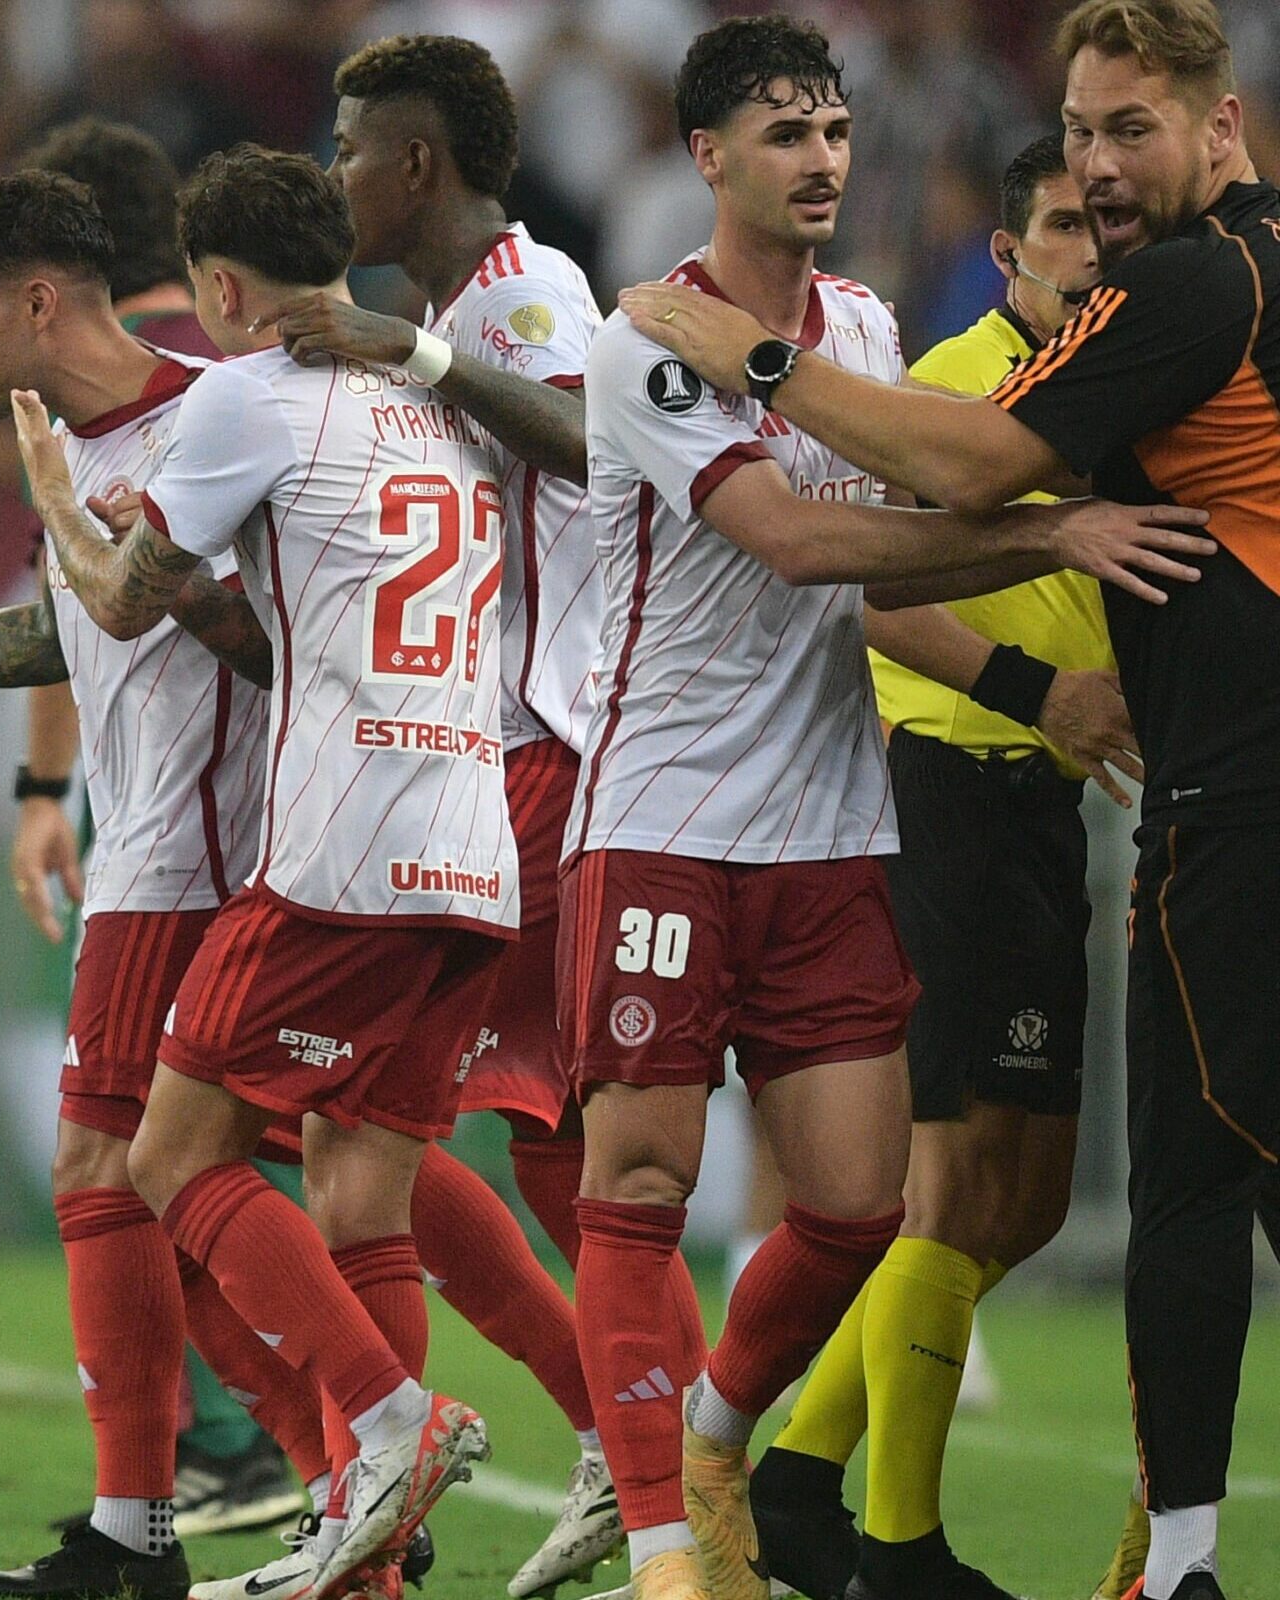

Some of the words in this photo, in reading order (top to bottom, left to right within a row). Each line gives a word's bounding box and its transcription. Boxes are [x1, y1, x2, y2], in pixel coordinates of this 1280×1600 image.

[391, 861, 500, 901] Unimed
[615, 907, 691, 979] 30
[278, 1028, 353, 1059] ESTRELA
[301, 1049, 338, 1069] BET
